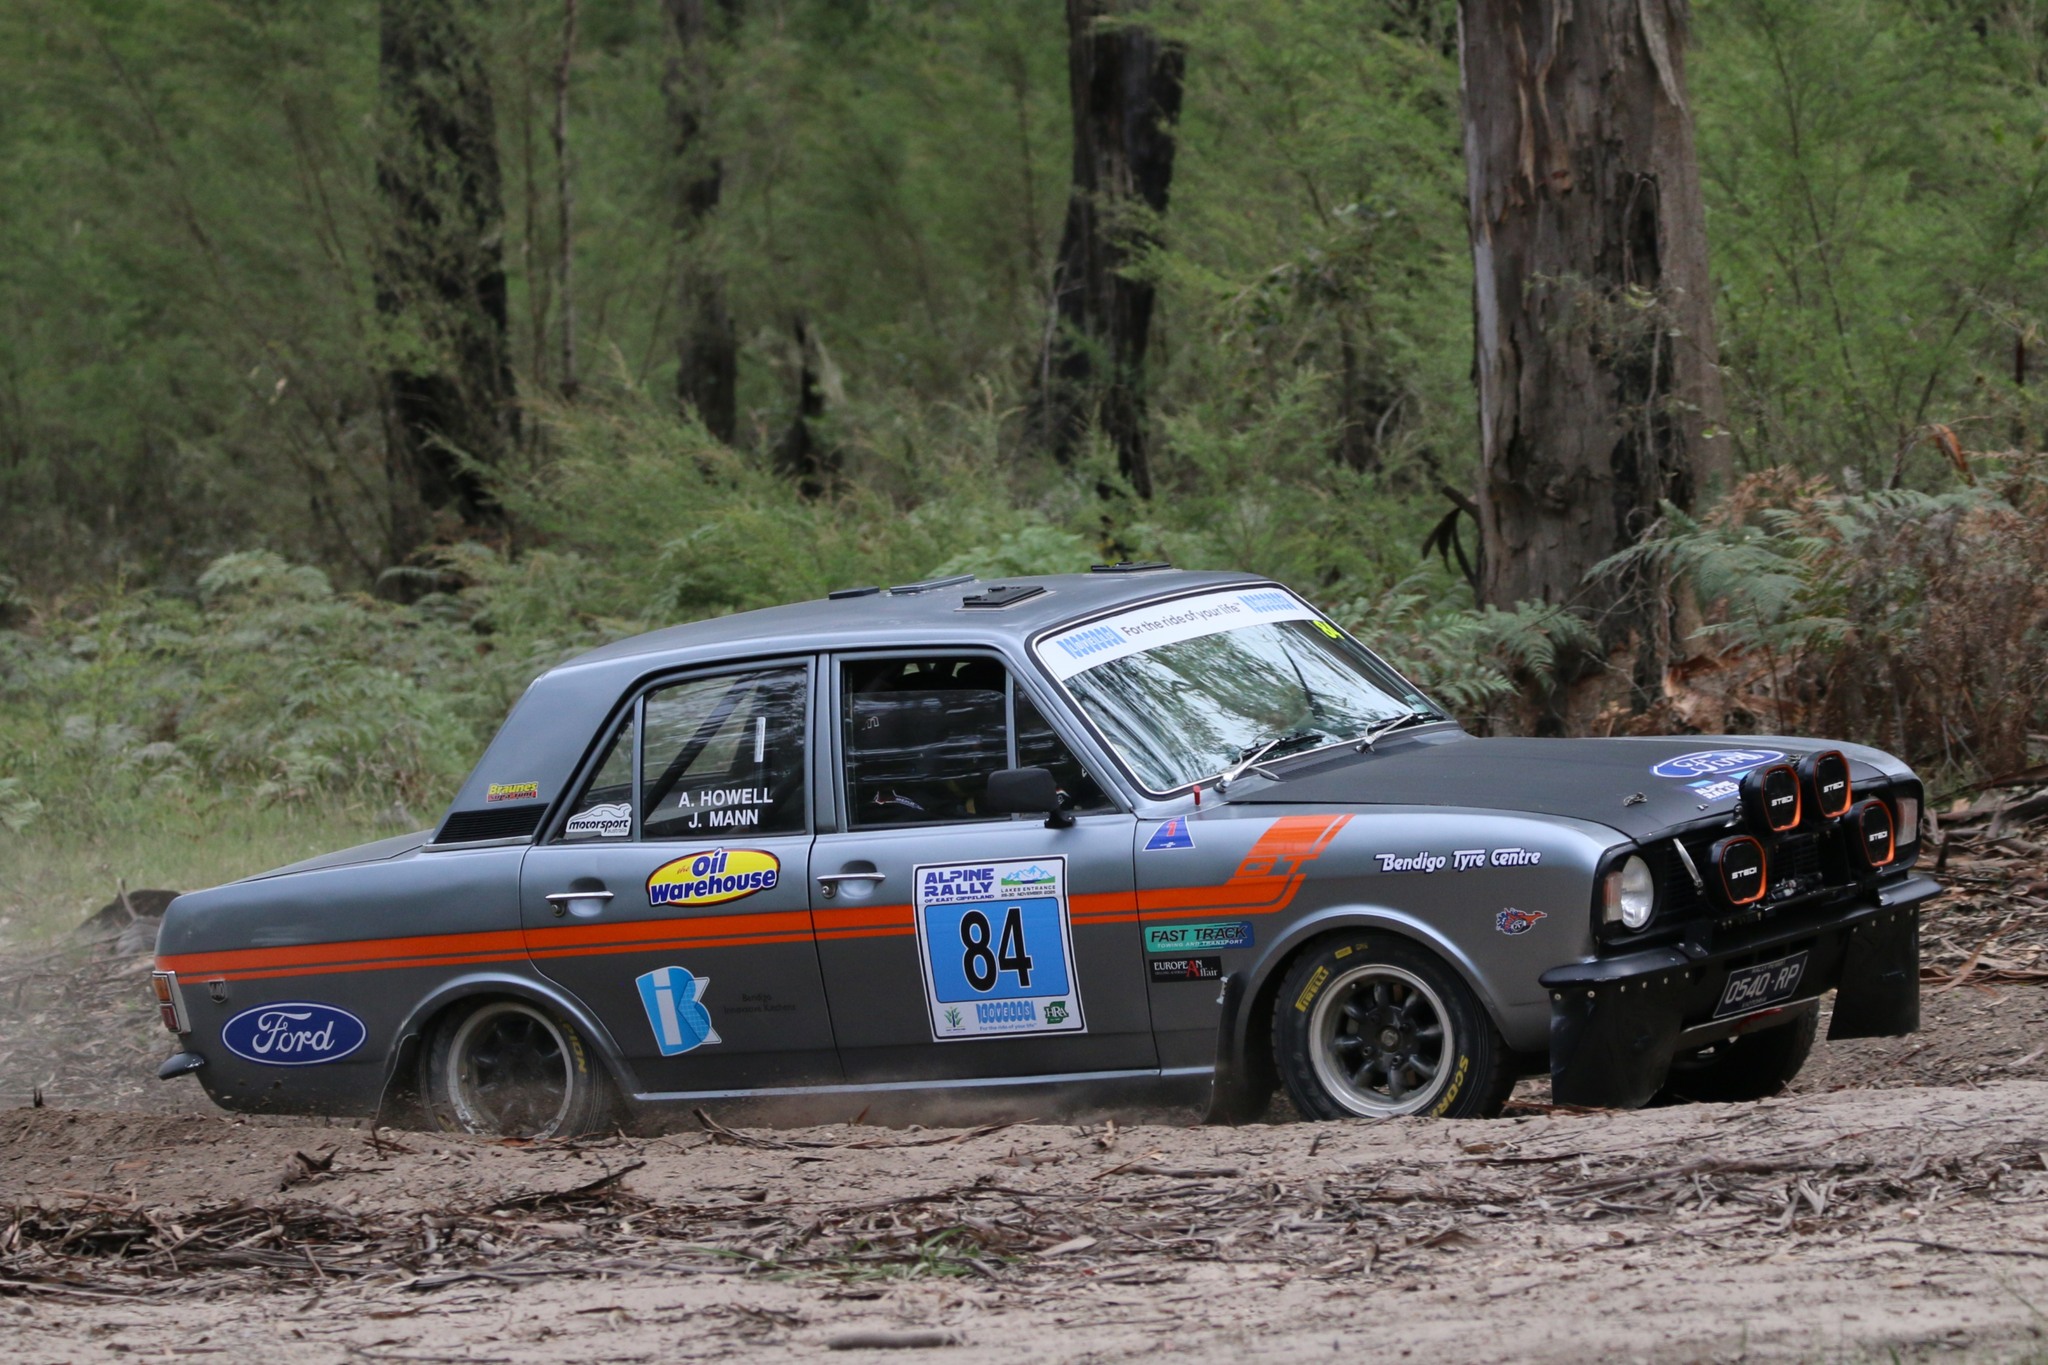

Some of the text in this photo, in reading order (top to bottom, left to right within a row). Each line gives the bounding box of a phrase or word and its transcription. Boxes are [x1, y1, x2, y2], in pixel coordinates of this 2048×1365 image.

[1121, 625, 1143, 636] For
[1143, 620, 1163, 632] the
[1162, 614, 1186, 627] ride
[1185, 610, 1198, 621] of
[1196, 604, 1221, 621] your
[1672, 751, 1764, 772] Ford
[488, 783, 537, 795] Braunes
[1823, 780, 1844, 793] STEDI
[678, 787, 773, 808] A. HOWELL
[1771, 795, 1794, 807] STEDI
[568, 818, 629, 832] motorsport
[688, 809, 759, 829] J. MANN
[1869, 830, 1888, 842] STEDI
[691, 849, 728, 877] Oil
[1235, 853, 1320, 877] GT
[1374, 847, 1542, 873] Bendigo Tyre Centre
[925, 868, 995, 885] ALPINE
[1731, 866, 1758, 880] STEDI
[650, 868, 777, 904] Warehouse
[924, 881, 993, 897] RALLY
[1151, 925, 1248, 943] FAST TRACK
[1201, 939, 1243, 947] TRANSPORT
[959, 906, 1034, 993] 84
[1154, 959, 1203, 976] EUROPEAN
[1295, 965, 1329, 1013] PIRELLI
[980, 1004, 1033, 1019] LOVELLS
[252, 1011, 335, 1054] Ford
